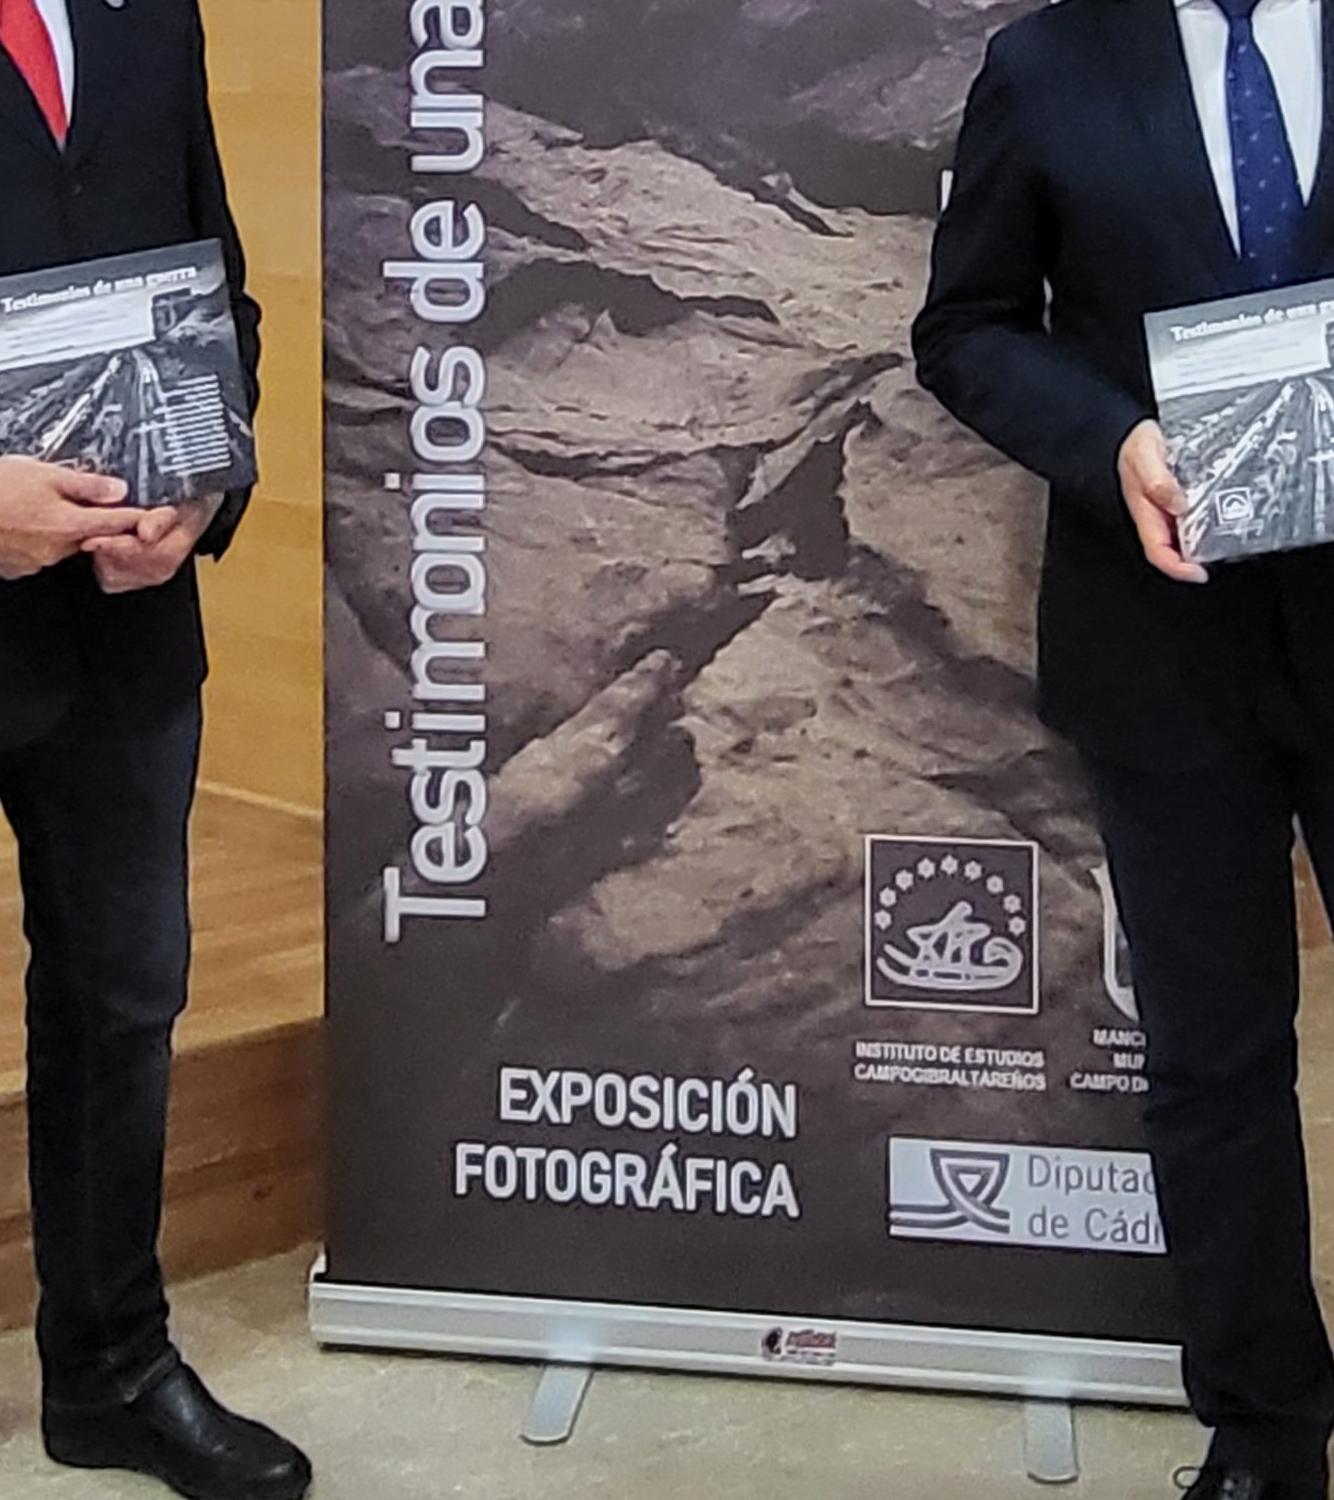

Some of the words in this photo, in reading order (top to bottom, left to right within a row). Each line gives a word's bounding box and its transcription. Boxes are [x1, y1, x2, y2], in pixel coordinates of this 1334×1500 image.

[383, 200, 485, 323] de
[383, 345, 486, 943] Testimonios
[854, 1064, 1047, 1091] CAMPOGIBRALTAREÑOS
[855, 1041, 936, 1062] INSTITUTO
[939, 1046, 961, 1063] DE
[965, 1048, 1045, 1068] ESTUDIOS
[500, 1067, 797, 1138] EXPOSICIÓN
[1070, 1071, 1130, 1093] CAMPO
[456, 1142, 800, 1218] FOTOGRÁFICA
[1028, 1205, 1069, 1239] de
